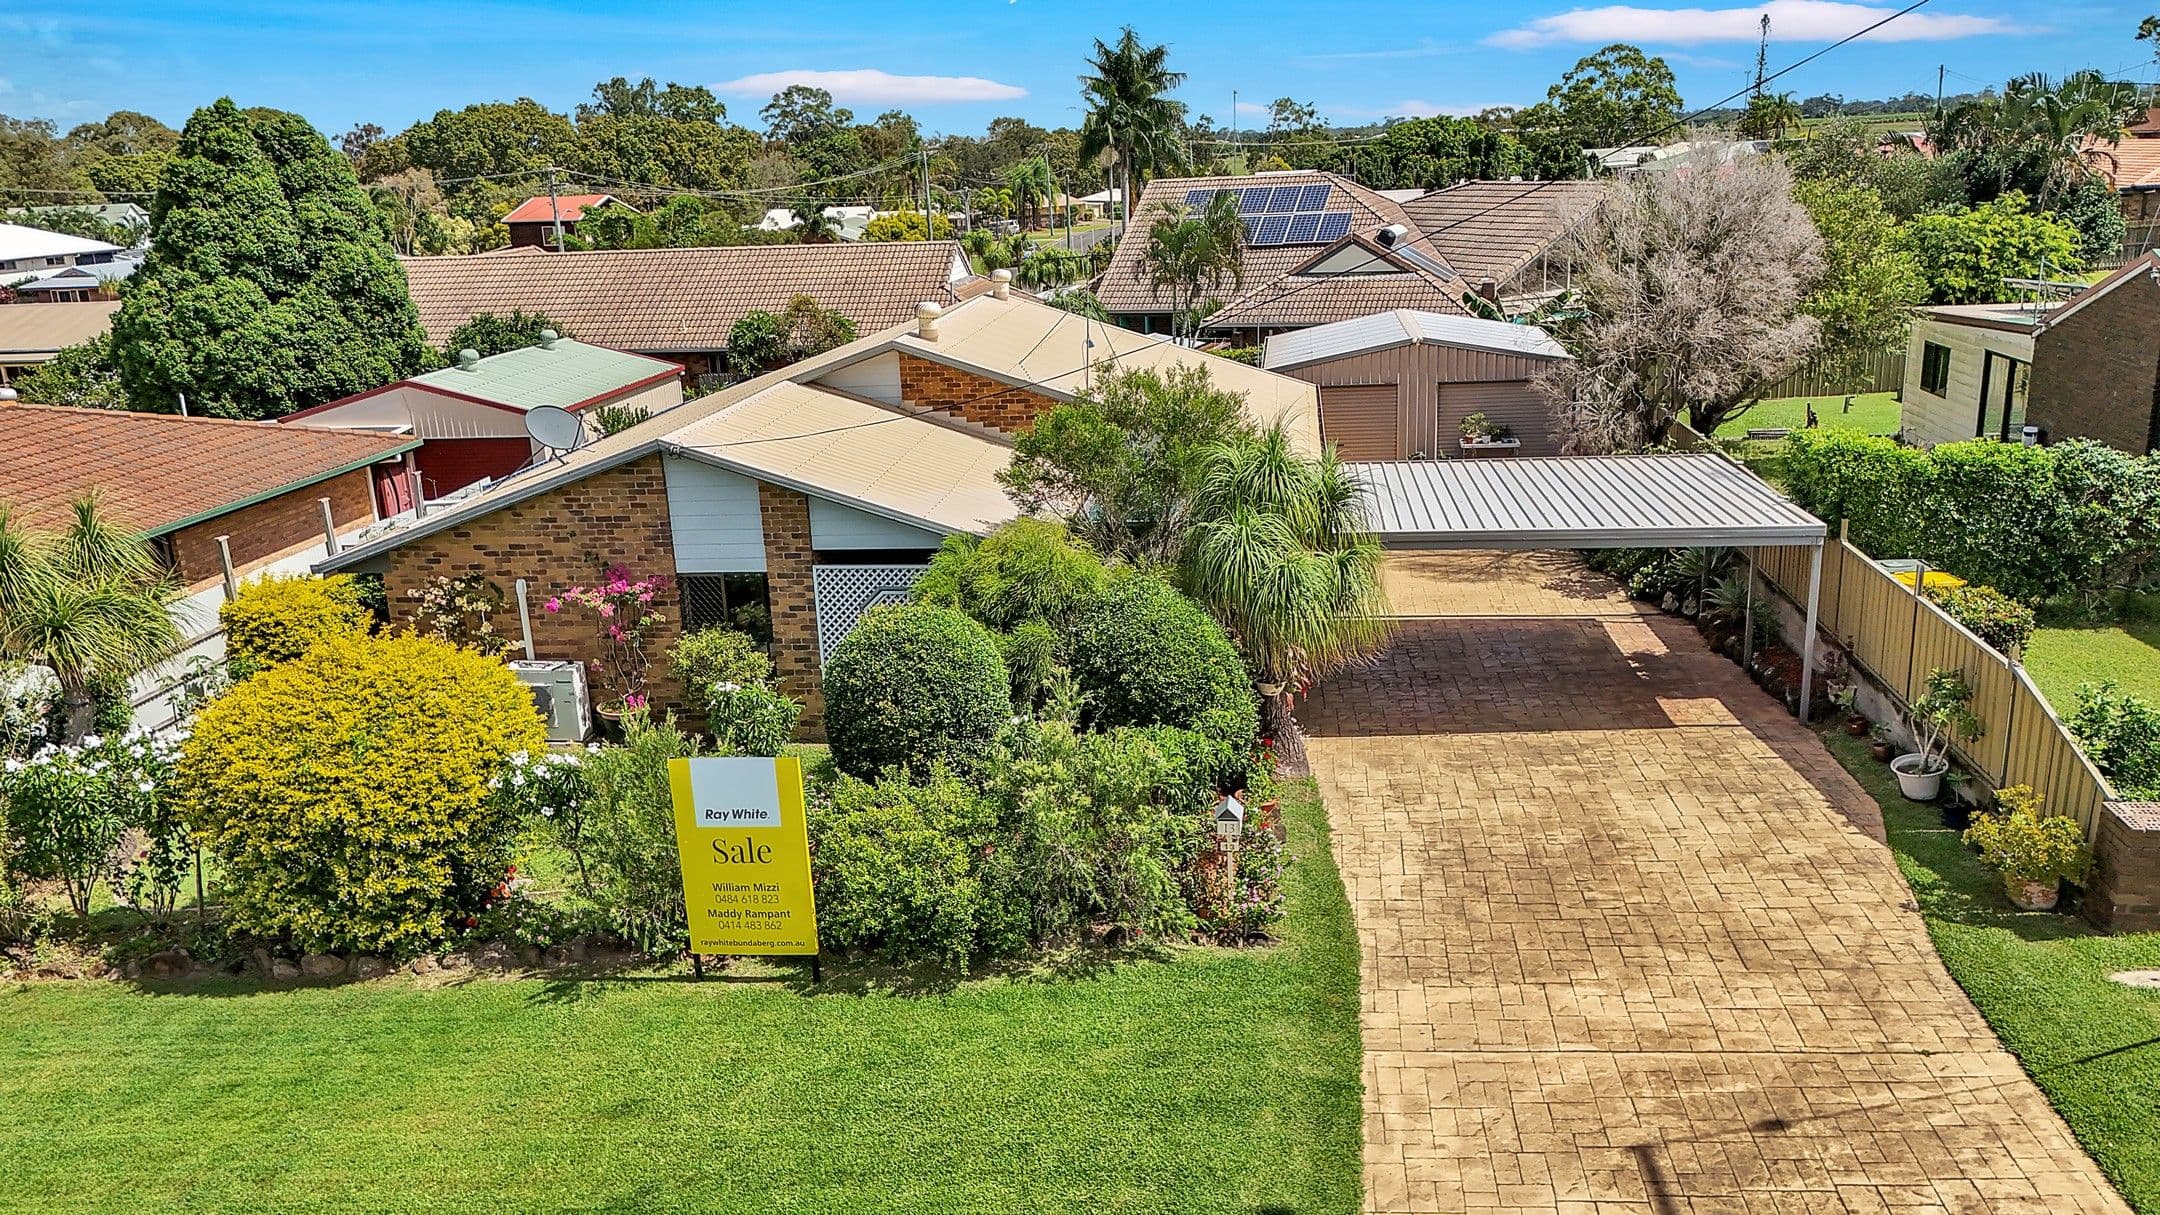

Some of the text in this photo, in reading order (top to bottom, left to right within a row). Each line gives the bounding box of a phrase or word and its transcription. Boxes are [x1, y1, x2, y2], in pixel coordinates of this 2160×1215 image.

[705, 809, 729, 821] Ray
[1224, 823, 1235, 833] 13
[712, 836, 773, 865] Sale
[712, 883, 780, 892] William Mizzi
[715, 895, 780, 904] 0484 618 823
[707, 909, 791, 920] Maddy Rampant
[718, 921, 782, 930] 0414 483 862
[700, 939, 806, 948] raywhitebundaberg.com.au
